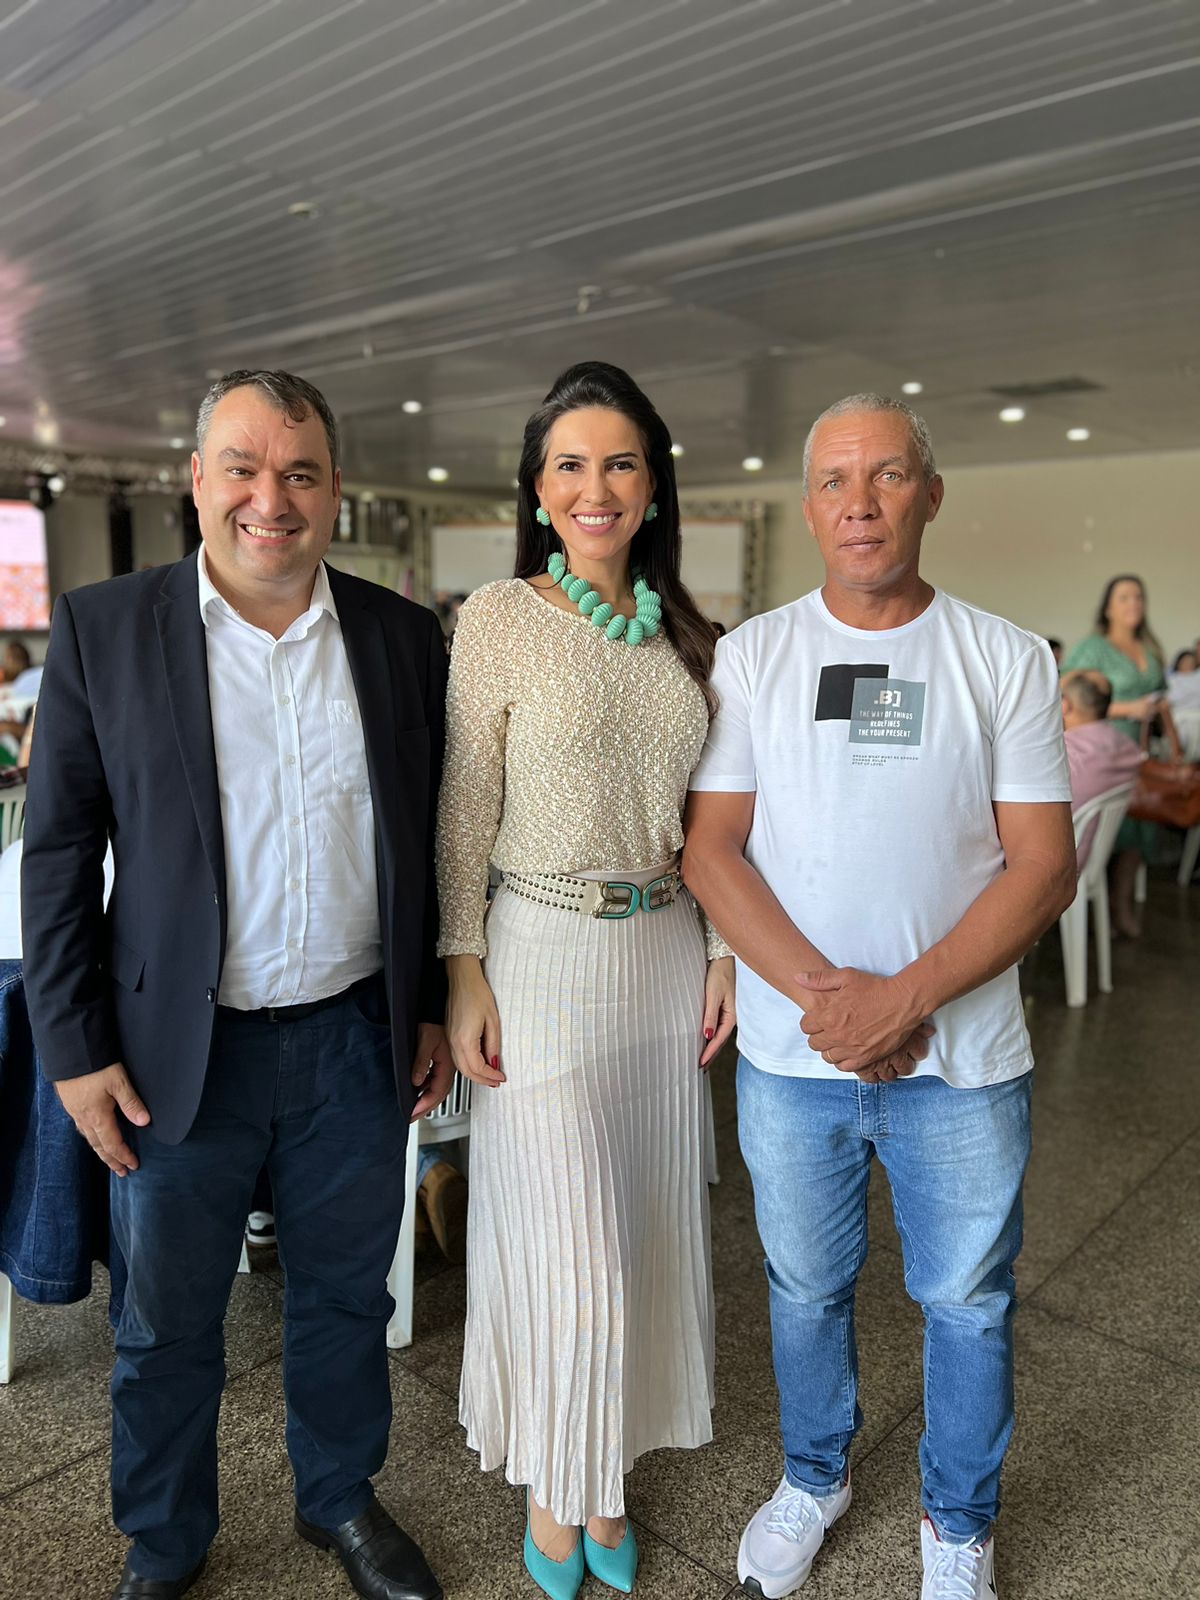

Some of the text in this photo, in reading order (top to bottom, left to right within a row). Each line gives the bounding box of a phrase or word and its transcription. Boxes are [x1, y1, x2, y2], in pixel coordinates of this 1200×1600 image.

[860, 710, 913, 720] THE WAY OF THINGS
[870, 720, 900, 728] REDEFINES
[858, 728, 911, 738] THE YOUR PRESENT
